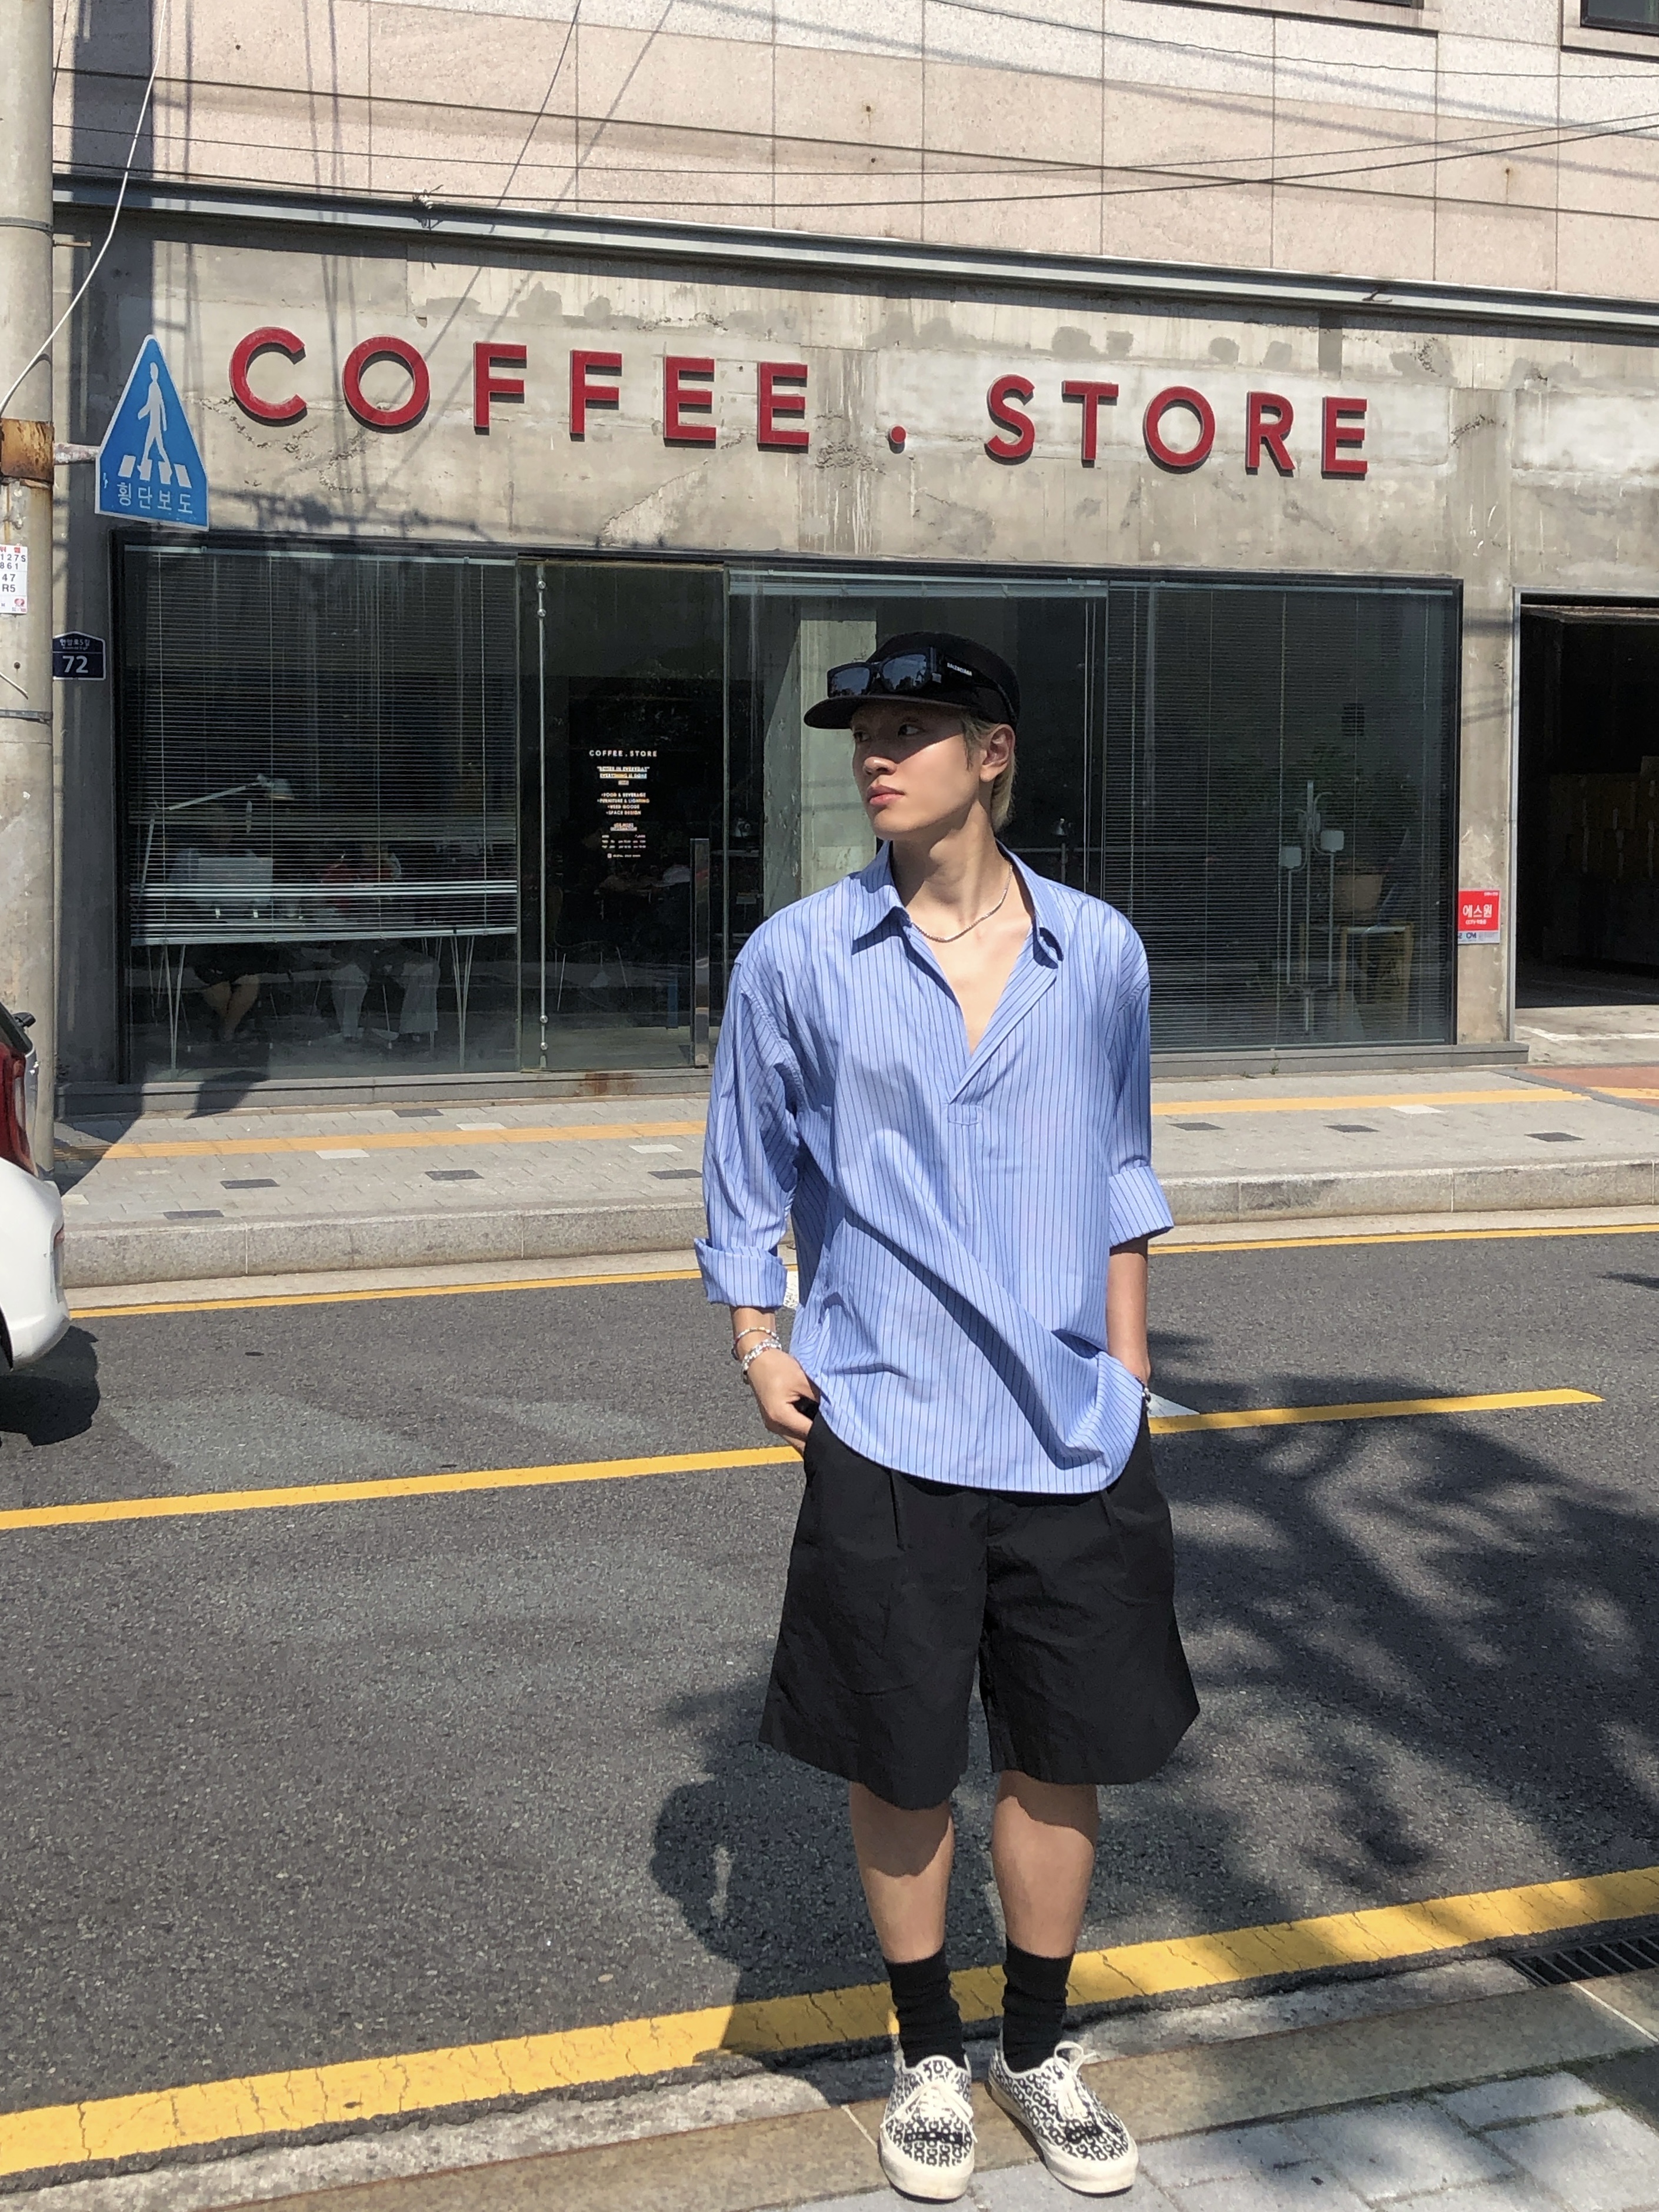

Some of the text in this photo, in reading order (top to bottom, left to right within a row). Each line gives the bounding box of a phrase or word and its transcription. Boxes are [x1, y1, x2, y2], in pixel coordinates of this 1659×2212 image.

[229, 326, 810, 449] COFFEE
[984, 374, 1368, 475] STORE
[117, 482, 193, 514] 횡단보도
[2, 574, 16, 582] 47
[2, 584, 16, 593] R5
[62, 655, 88, 673] 72
[1462, 904, 1493, 918] 에스원
